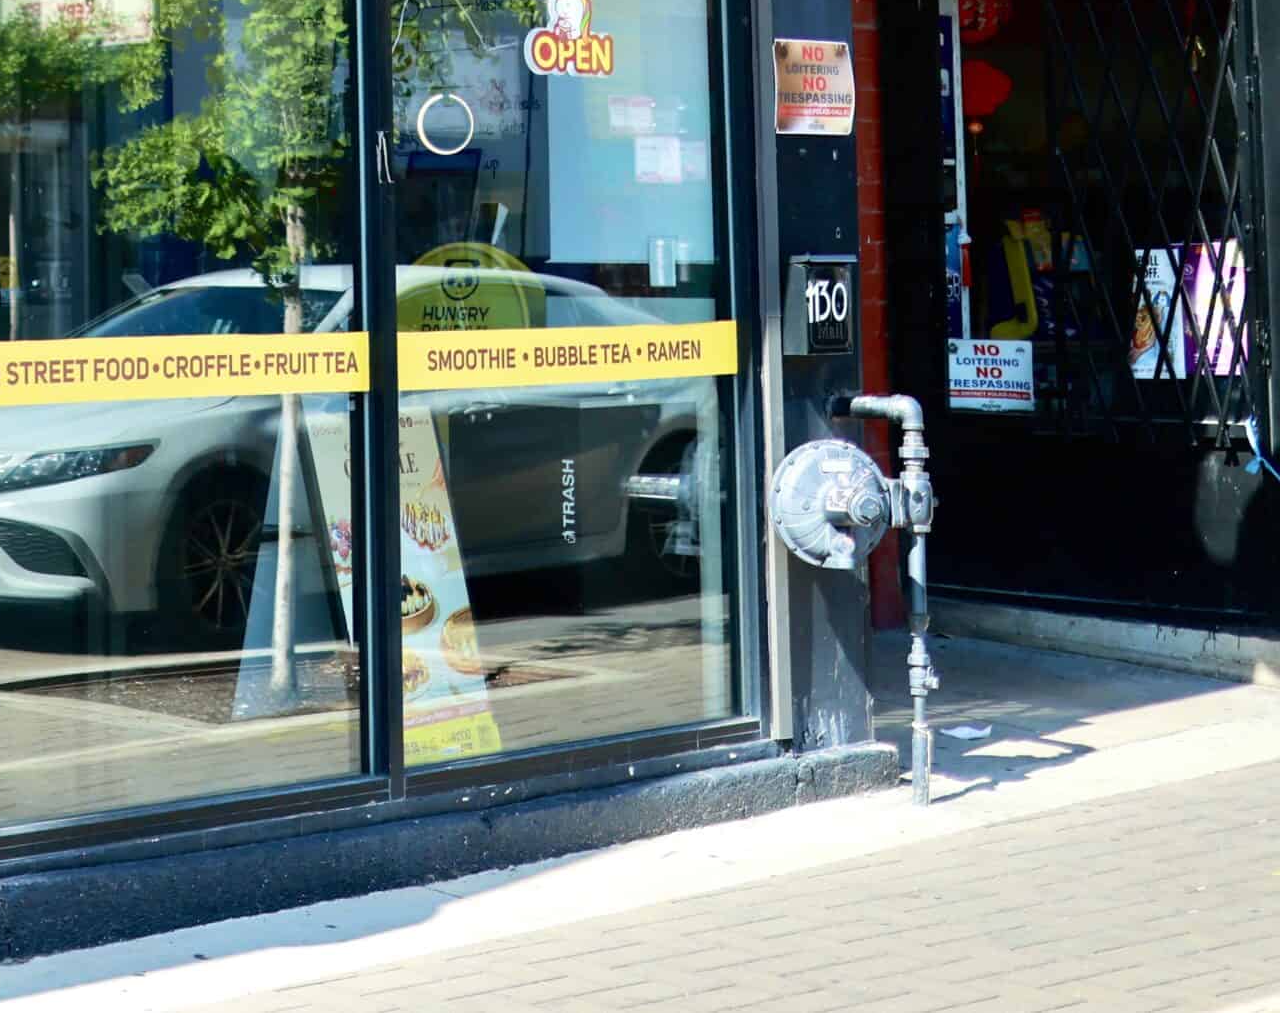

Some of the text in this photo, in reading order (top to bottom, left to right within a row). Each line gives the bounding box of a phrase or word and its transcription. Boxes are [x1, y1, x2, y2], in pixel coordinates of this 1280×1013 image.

[533, 34, 612, 73] OPEN
[801, 45, 824, 62] NO
[785, 64, 839, 76] LOITERING
[802, 75, 827, 92] NO
[778, 91, 853, 105] TRESPASSING
[423, 306, 490, 322] HUNGRY
[427, 339, 701, 372] SMOOTHIE BUBBLE TEA RAMEN
[972, 343, 1000, 356] NO
[6, 358, 89, 385] STREET
[93, 356, 150, 382] FOOD
[163, 353, 252, 379] CROFFLE
[264, 351, 320, 376] FRUIT
[322, 351, 359, 374] TEA
[955, 357, 1020, 368] LOITERING
[975, 367, 1003, 379] NO
[561, 458, 576, 529] TRASH
